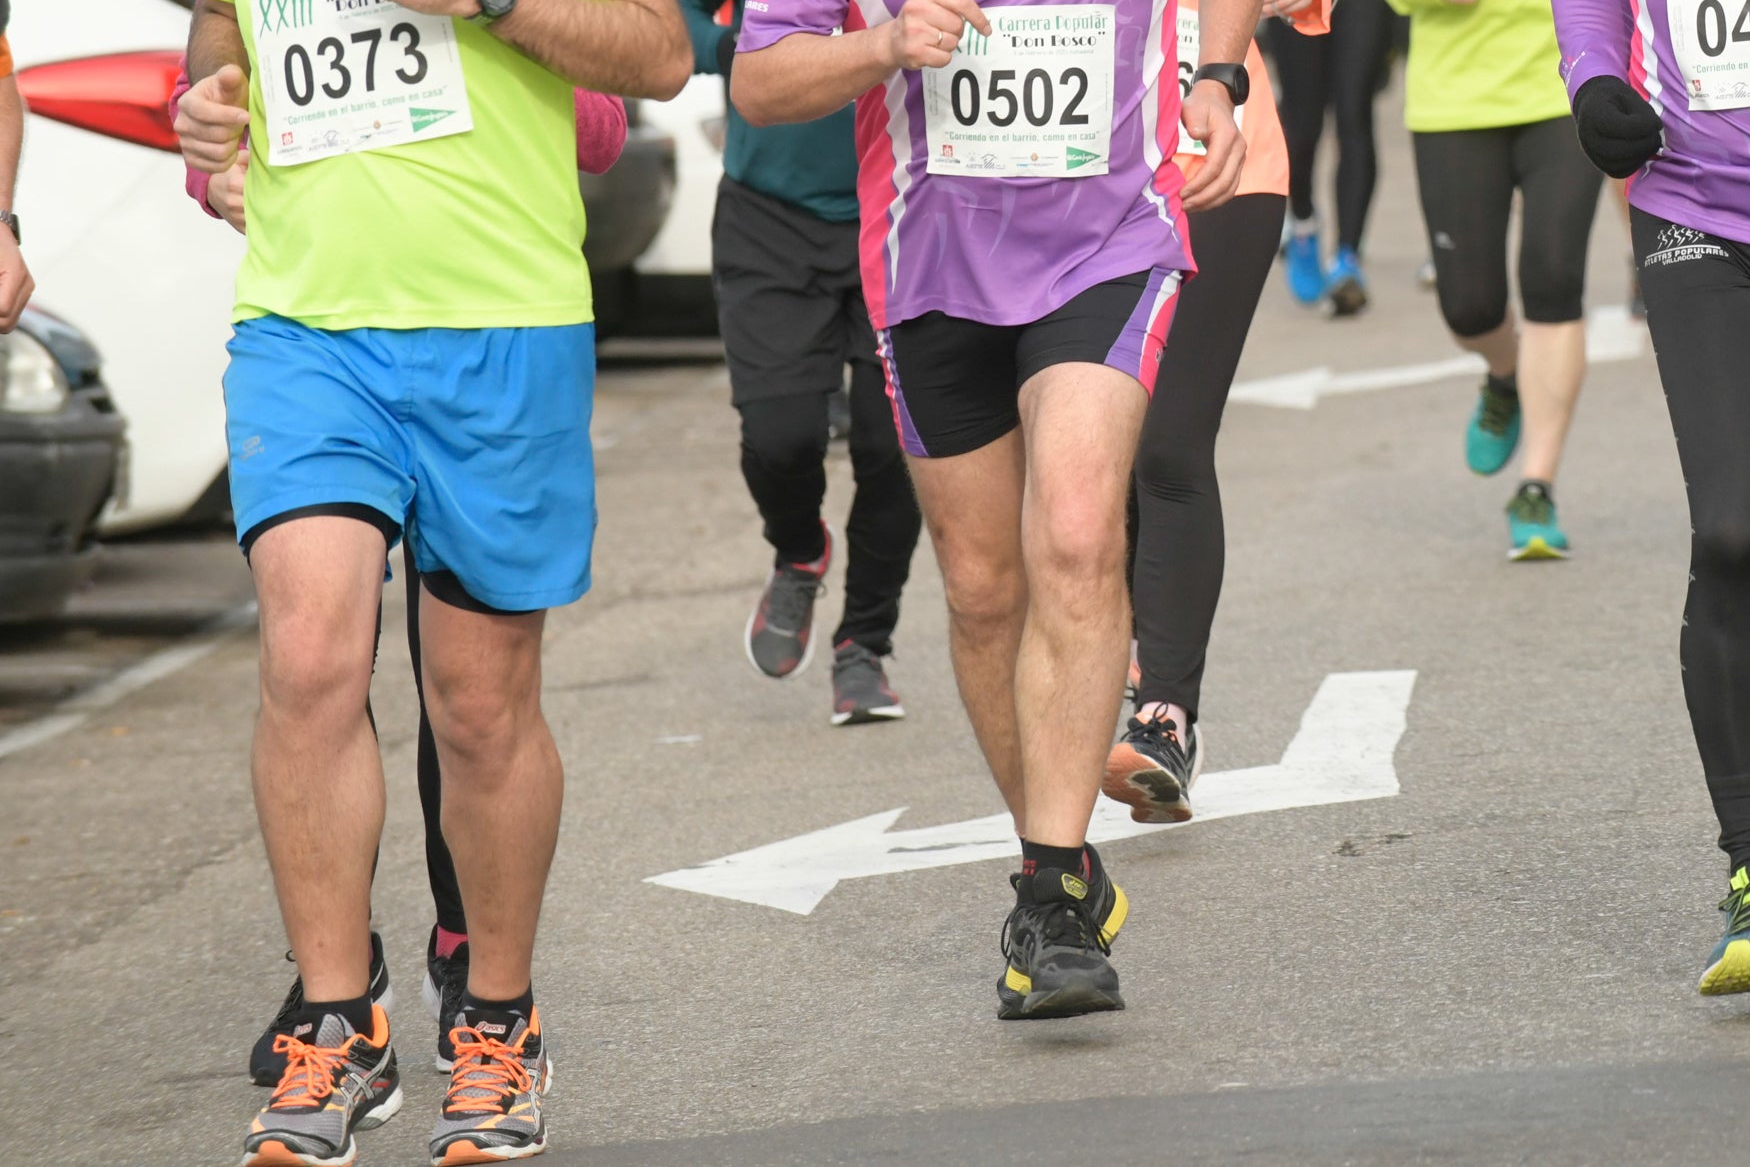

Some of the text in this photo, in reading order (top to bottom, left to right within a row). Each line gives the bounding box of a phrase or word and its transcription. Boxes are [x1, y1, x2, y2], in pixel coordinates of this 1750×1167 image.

[999, 16, 1050, 32] Carrera
[1056, 14, 1108, 33] Popular
[284, 22, 428, 107] 0373
[1738, 61, 1748, 70] en
[951, 67, 1089, 127] 0502
[989, 134, 1000, 142] en
[1002, 132, 1010, 142] el
[1042, 134, 1065, 142] como
[1067, 134, 1078, 142] en
[1662, 252, 1703, 266] VALLADOLID
[1674, 246, 1730, 258] POPULARES
